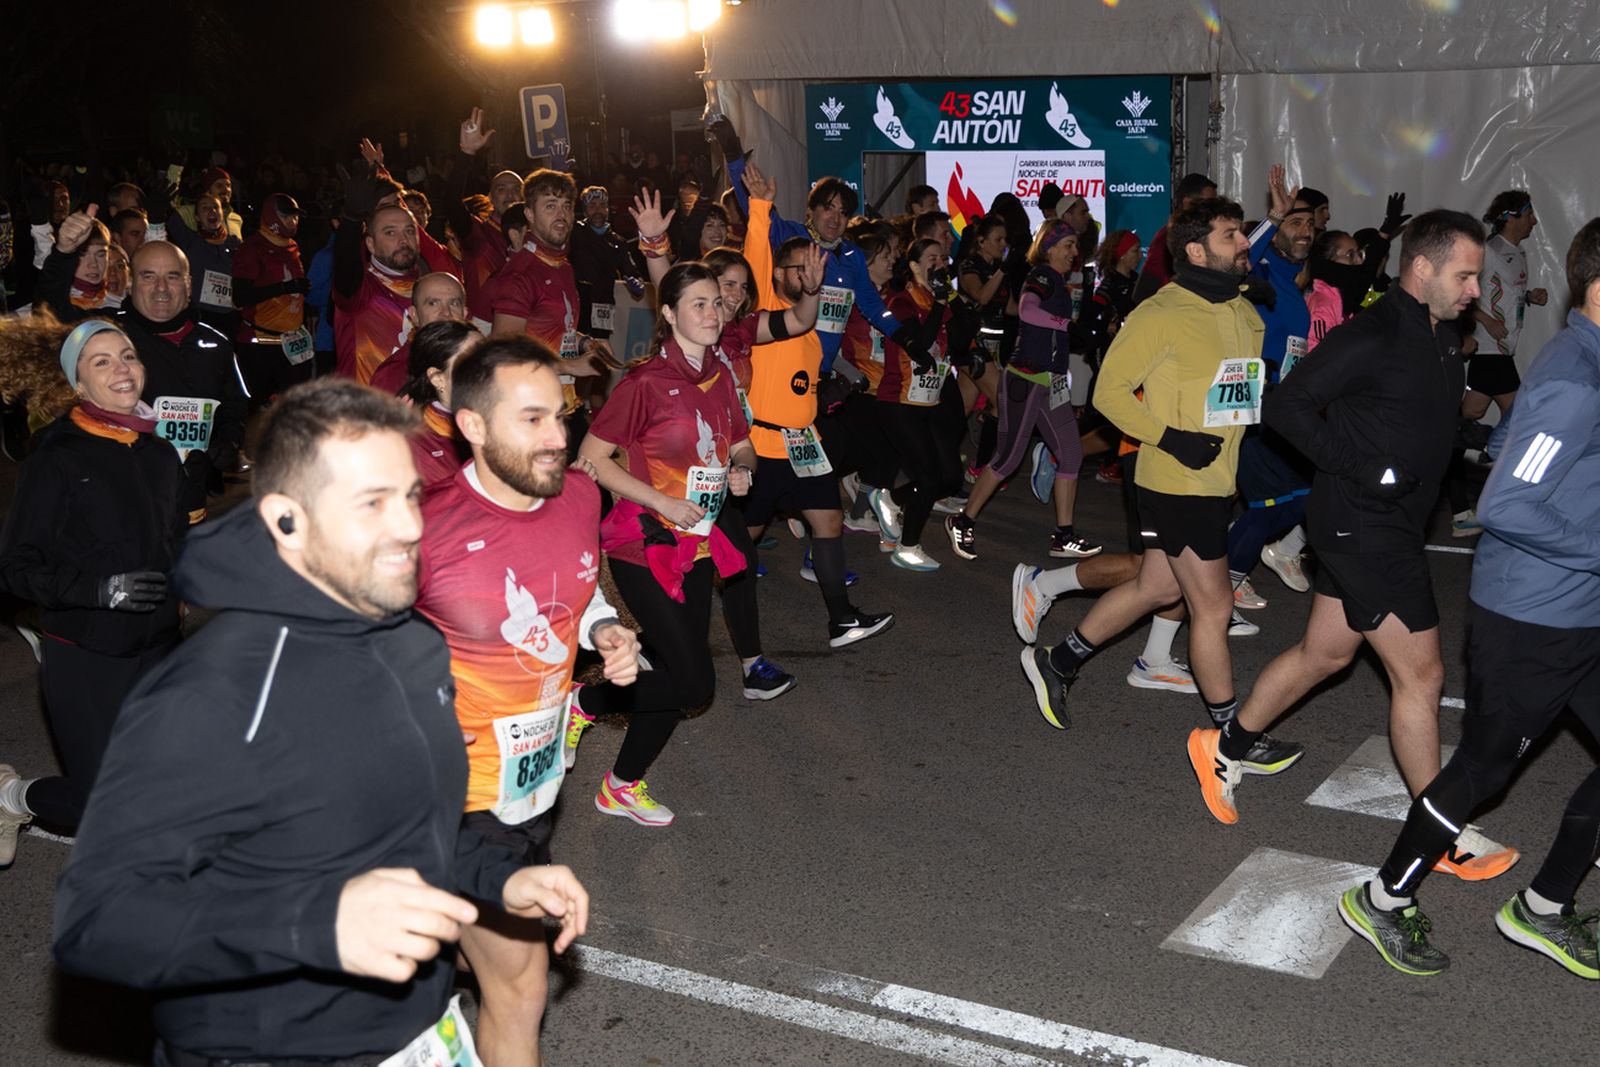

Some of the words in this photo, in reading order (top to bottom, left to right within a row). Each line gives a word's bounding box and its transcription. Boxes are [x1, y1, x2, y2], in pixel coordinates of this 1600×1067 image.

[531, 94, 558, 149] P
[885, 121, 901, 139] 43
[932, 112, 1021, 144] ANTÓN
[1059, 119, 1076, 137] 43
[1017, 169, 1046, 178] NOCHE
[1047, 169, 1059, 178] DE
[1108, 182, 1165, 193] calderón
[1218, 382, 1251, 403] 7783
[160, 411, 176, 419] SAN
[165, 421, 207, 442] 9356
[521, 625, 549, 653] 43
[512, 741, 530, 756] SAN
[516, 738, 558, 788] 8365
